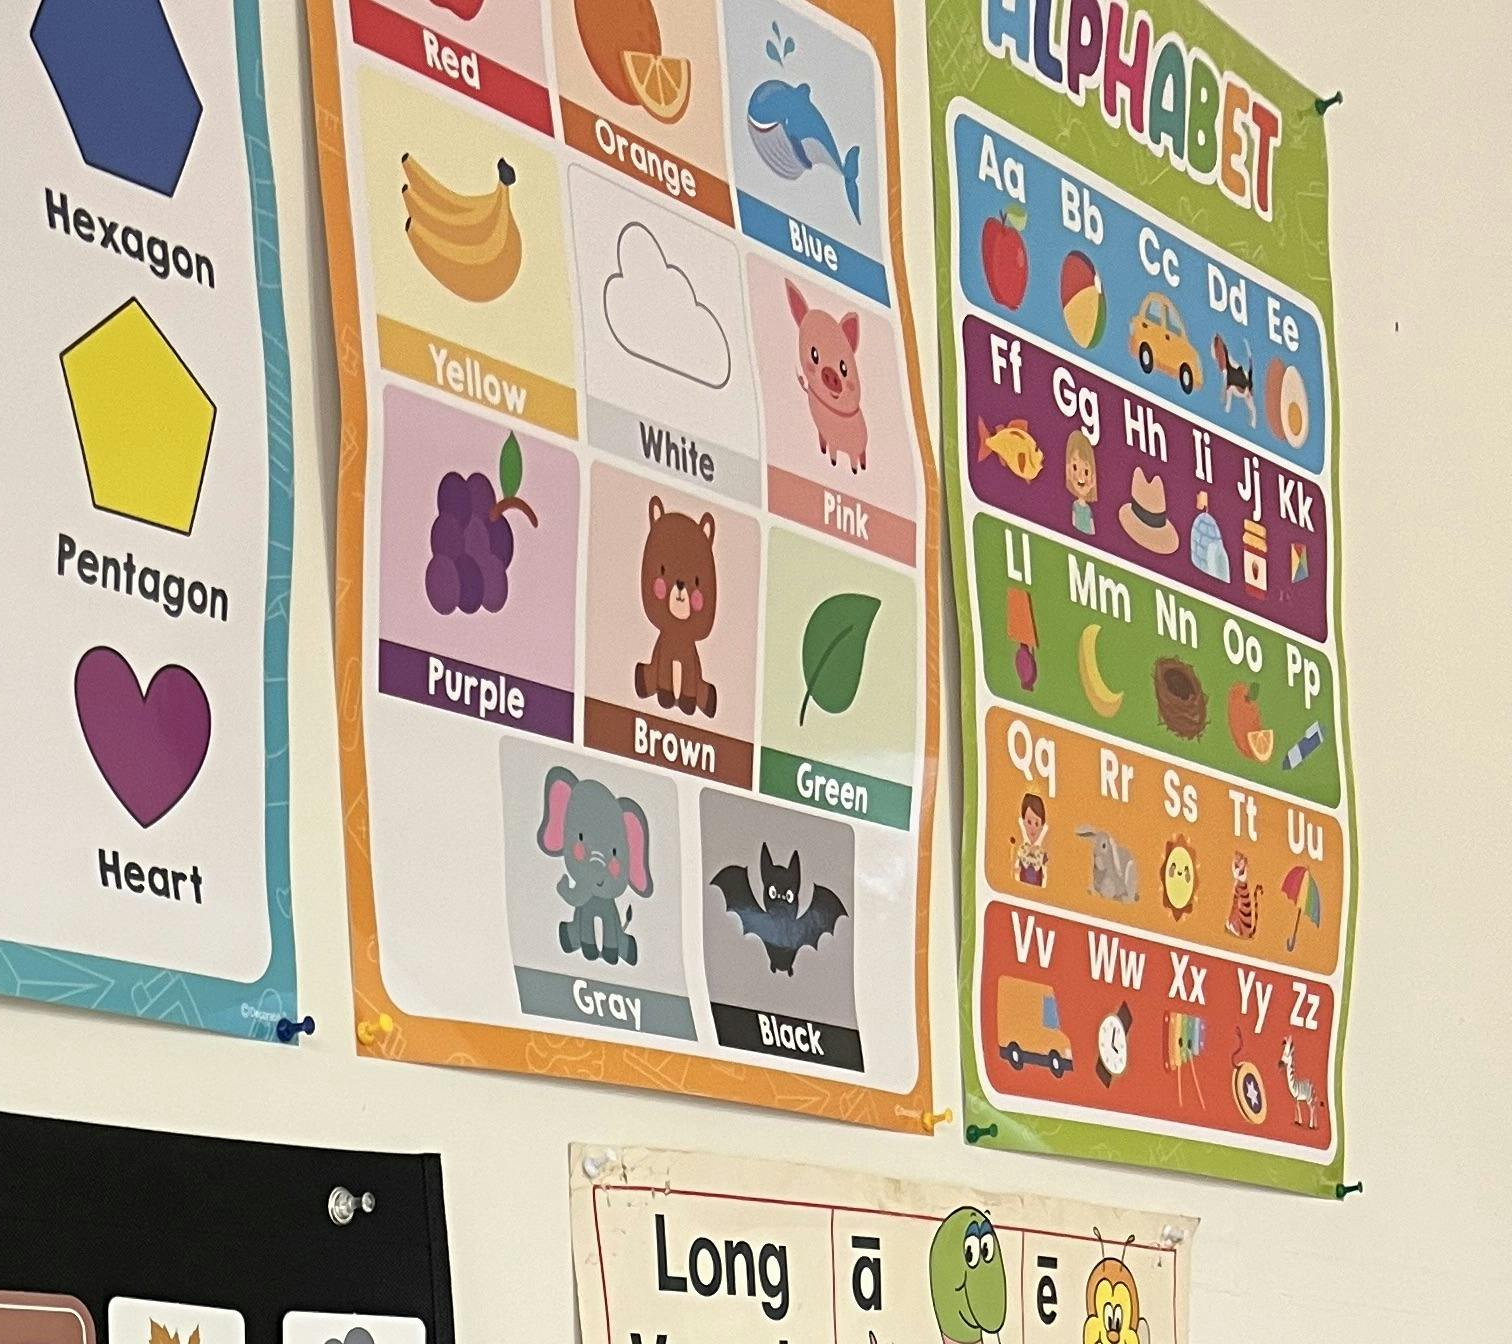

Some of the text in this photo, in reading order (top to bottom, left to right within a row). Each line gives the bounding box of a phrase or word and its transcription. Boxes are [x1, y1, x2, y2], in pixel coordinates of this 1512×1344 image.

[422, 28, 481, 90] Red
[987, 0, 1279, 213] ALPHABET
[595, 118, 697, 198] Orange
[44, 187, 215, 289] Hexagon
[788, 218, 838, 272] Blue
[978, 133, 1300, 352] Aa Bb Cc Dd Ee
[428, 343, 527, 415] Yellow
[639, 421, 715, 482] White
[990, 333, 1315, 533] Ff Gg Hh Ii Jj Kk
[823, 490, 869, 541] Pink
[57, 532, 229, 622] Pentagon
[1004, 528, 1321, 710] Ll Mm Nn Oo Pp
[428, 656, 525, 719] Purple
[634, 717, 716, 773] Brown
[796, 762, 868, 814] Green
[1007, 719, 1324, 862] Qq Rr Ss Tt Uu
[98, 848, 203, 905] Heart
[572, 979, 641, 1031] Gray
[1011, 911, 1321, 1034] Vv Ww Xx Yy Zz
[757, 1013, 825, 1056] Black
[654, 1213, 790, 1321] Long
